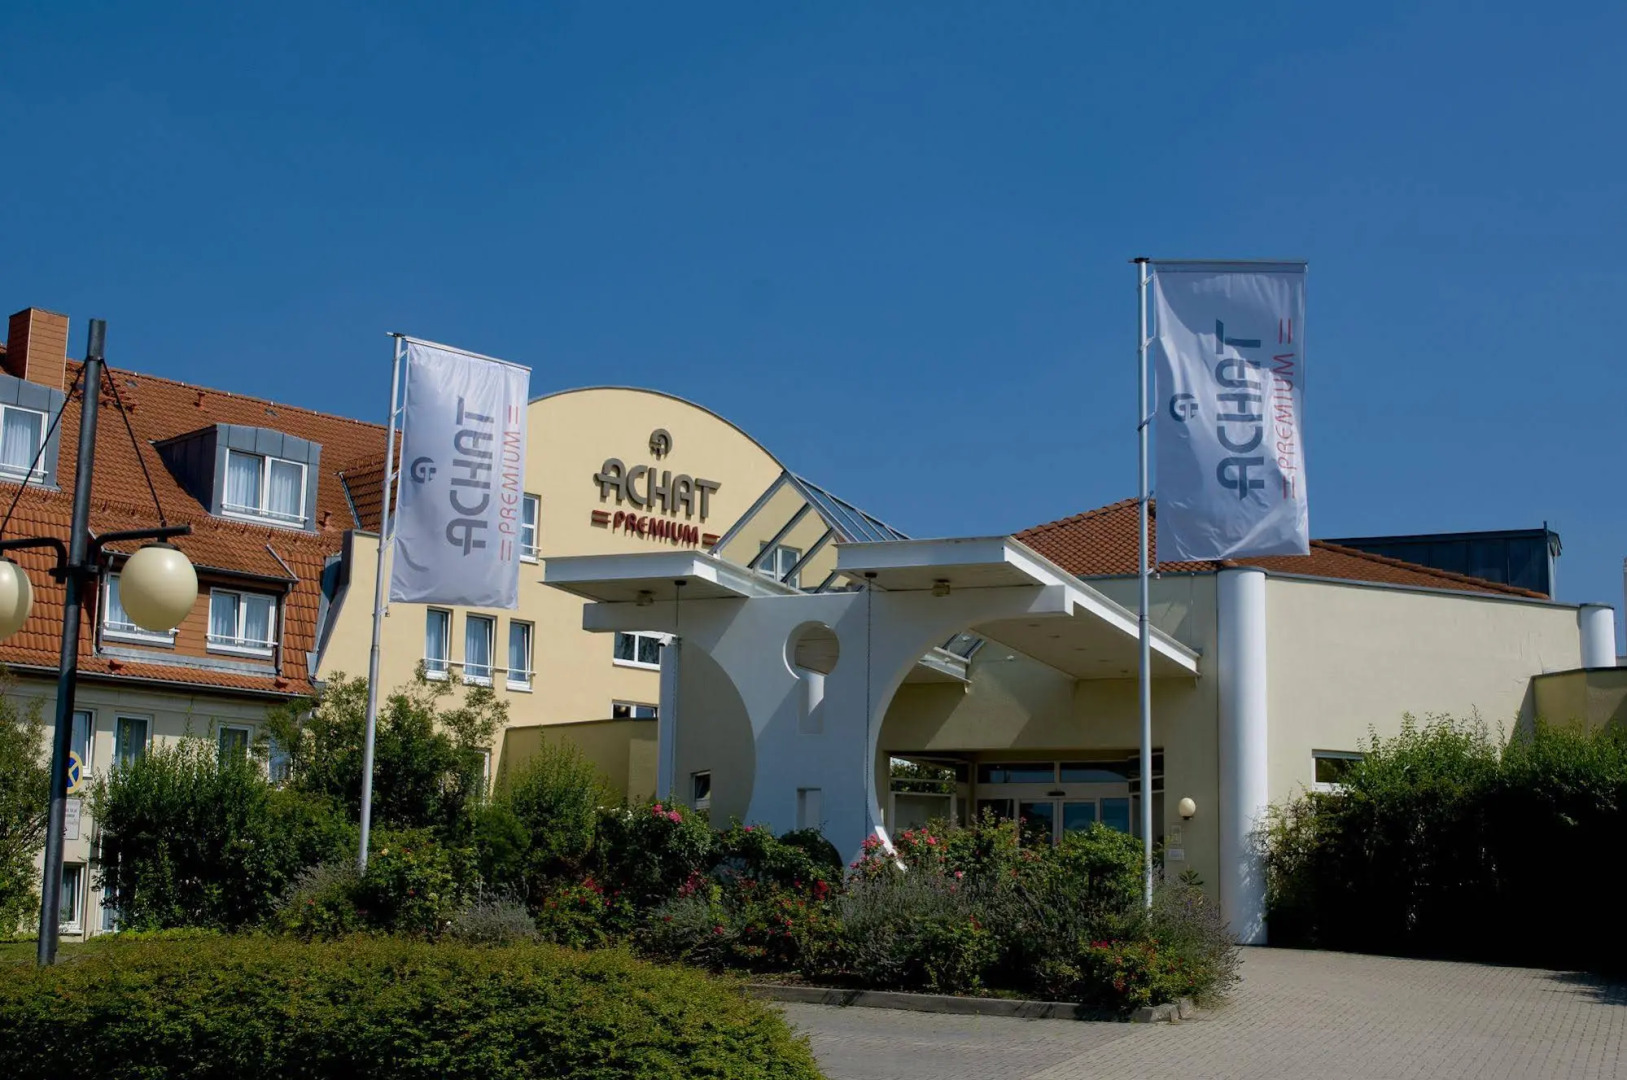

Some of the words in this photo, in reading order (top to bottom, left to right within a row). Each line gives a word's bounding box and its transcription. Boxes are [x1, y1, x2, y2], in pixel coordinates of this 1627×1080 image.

[1215, 318, 1264, 500] ACHAT
[1273, 353, 1295, 470] PREMIUM
[446, 396, 494, 557] ACHAT
[499, 431, 521, 535] PREMIUM
[593, 458, 721, 522] ACHAT
[612, 511, 699, 548] PREMIUM
